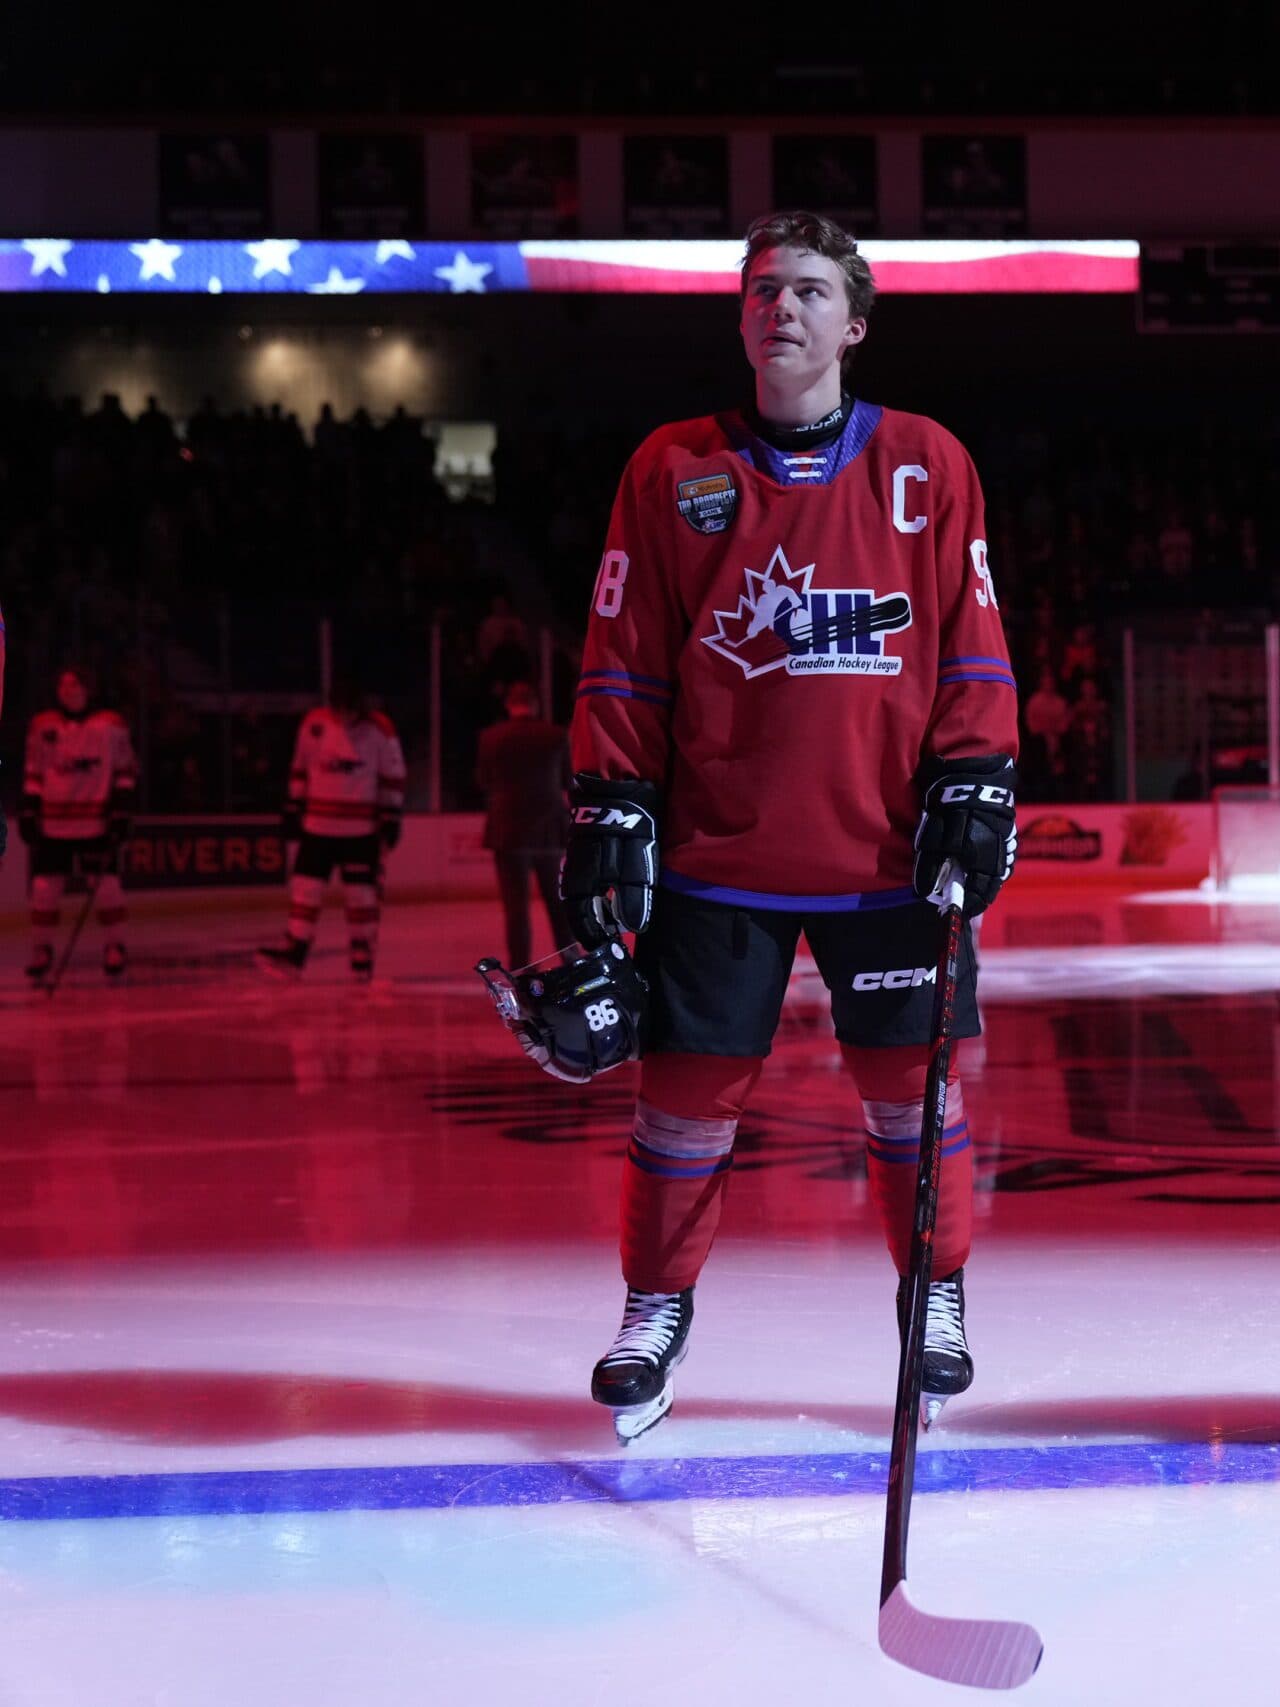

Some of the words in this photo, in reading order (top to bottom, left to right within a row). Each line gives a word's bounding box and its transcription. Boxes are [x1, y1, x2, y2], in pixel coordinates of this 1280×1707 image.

[892, 464, 928, 534] C
[590, 550, 629, 618] 8
[773, 593, 881, 656] CHL
[788, 657, 835, 670] Canadian
[837, 657, 871, 673] Hockey
[873, 660, 899, 673] League
[940, 784, 1015, 807] CC
[570, 807, 643, 829] CM
[127, 836, 284, 873] RIVERS
[851, 965, 938, 992] CCM
